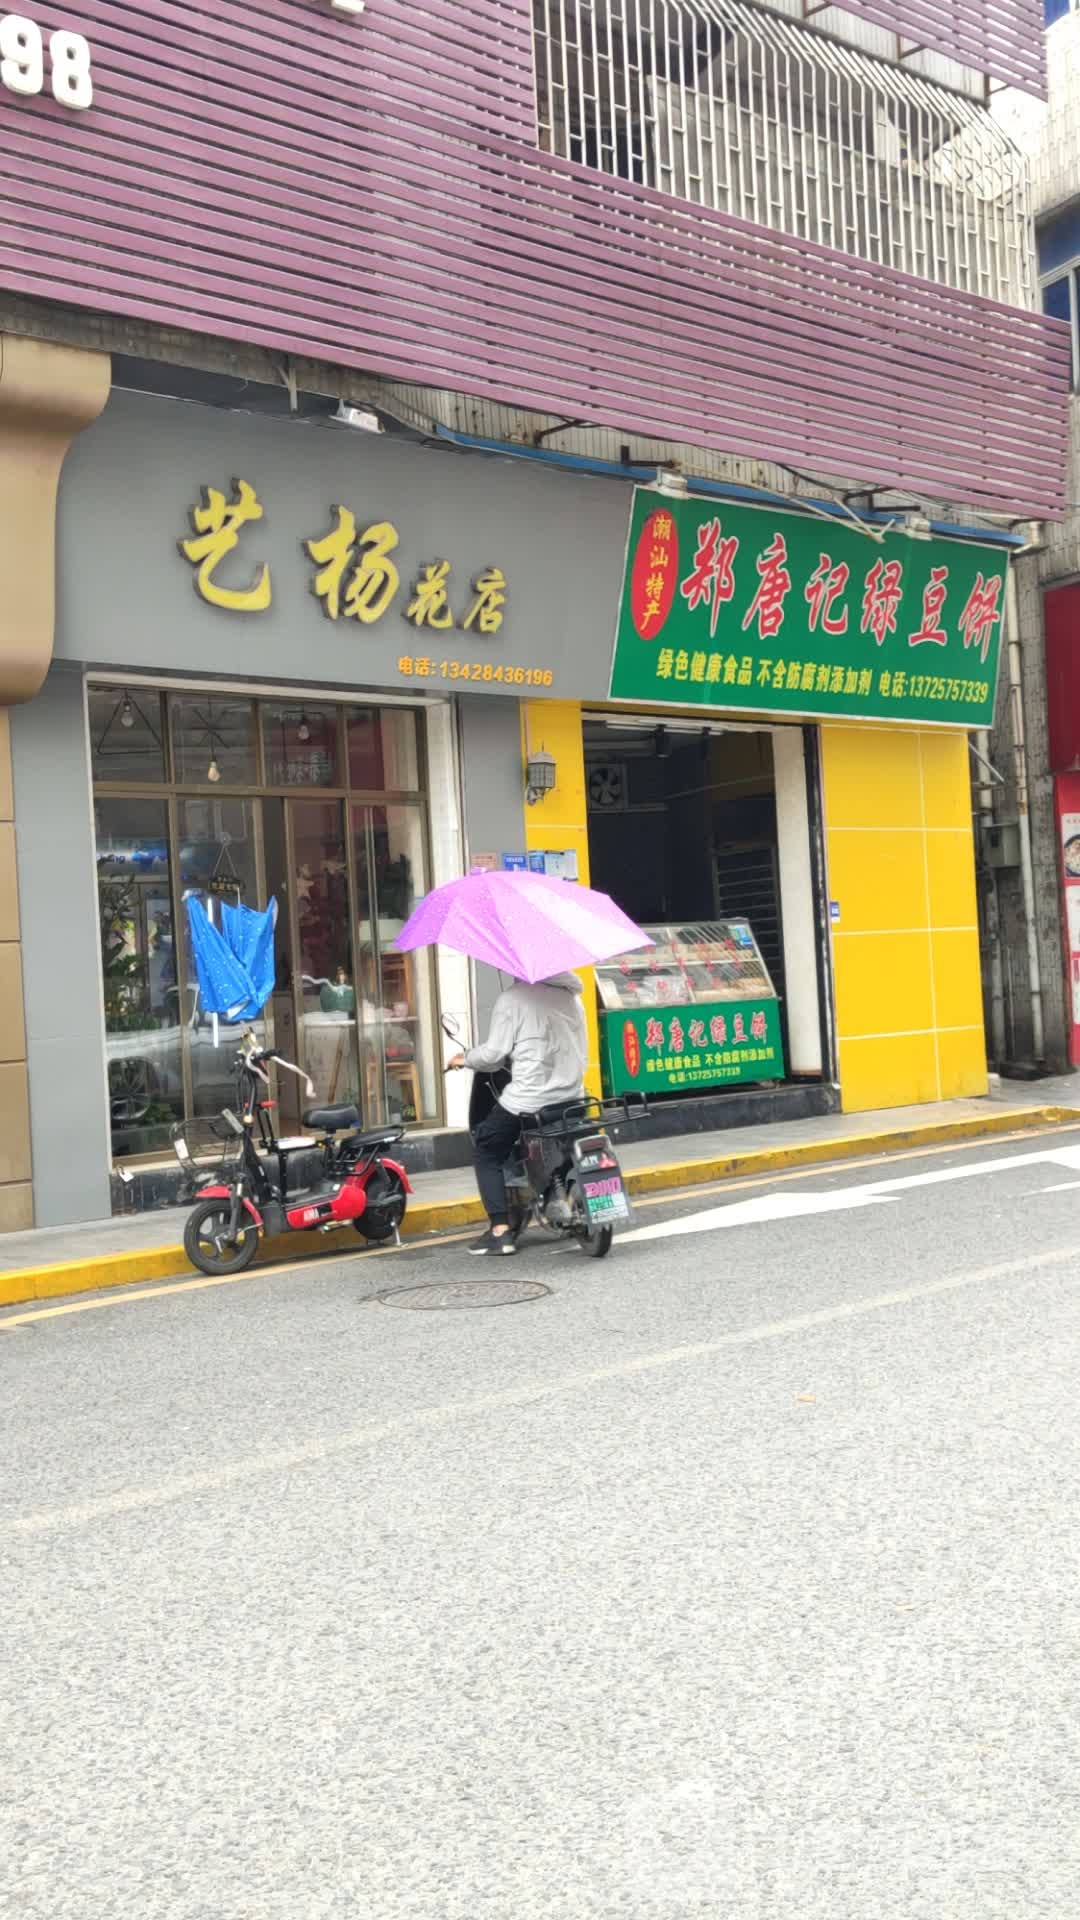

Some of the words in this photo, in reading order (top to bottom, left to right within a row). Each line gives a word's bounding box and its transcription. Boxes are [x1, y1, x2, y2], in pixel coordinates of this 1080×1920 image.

[0, 14, 93, 110] 98
[641, 516, 672, 631] 潮汕特产
[681, 517, 1002, 663] 郑唐记绿豆饼
[656, 647, 753, 686] 绿色健康食品
[757, 659, 873, 696] 不含防腐剂添加剂
